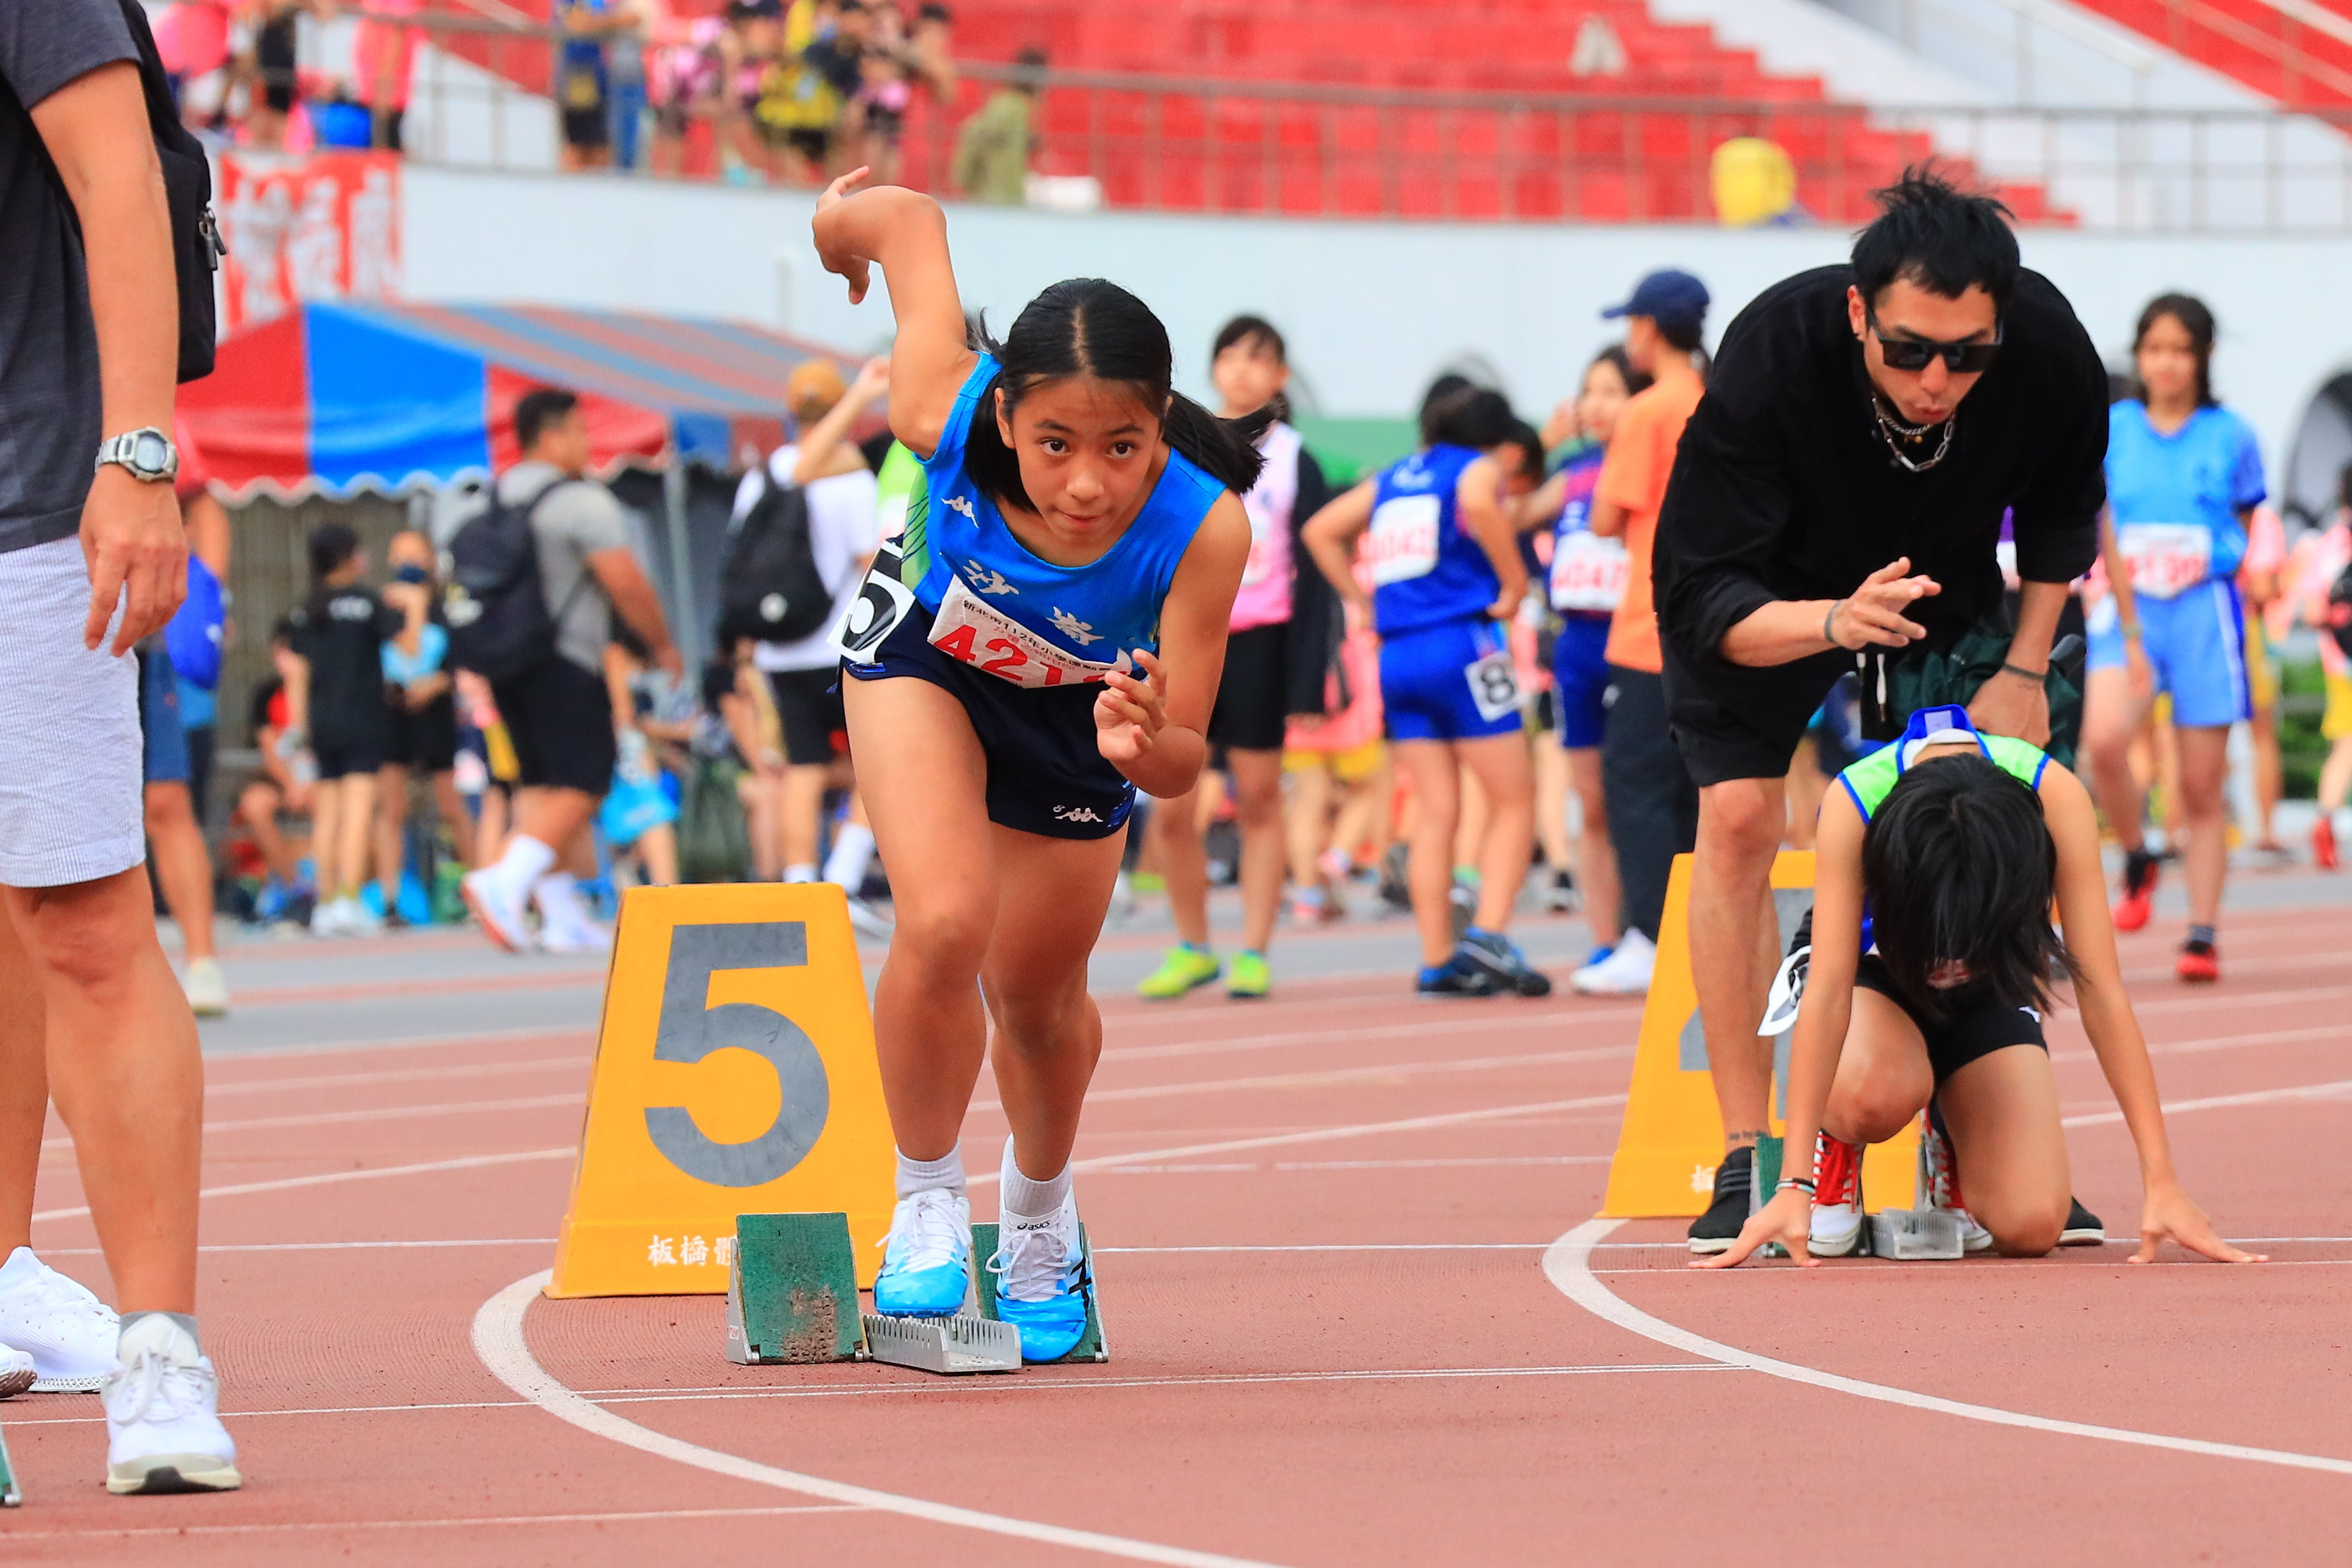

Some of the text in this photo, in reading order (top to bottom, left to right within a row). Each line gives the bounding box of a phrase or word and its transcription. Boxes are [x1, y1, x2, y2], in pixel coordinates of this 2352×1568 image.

[1480, 661, 1516, 705] 8
[644, 921, 829, 1187] 5
[1028, 1220, 1050, 1231] asics
